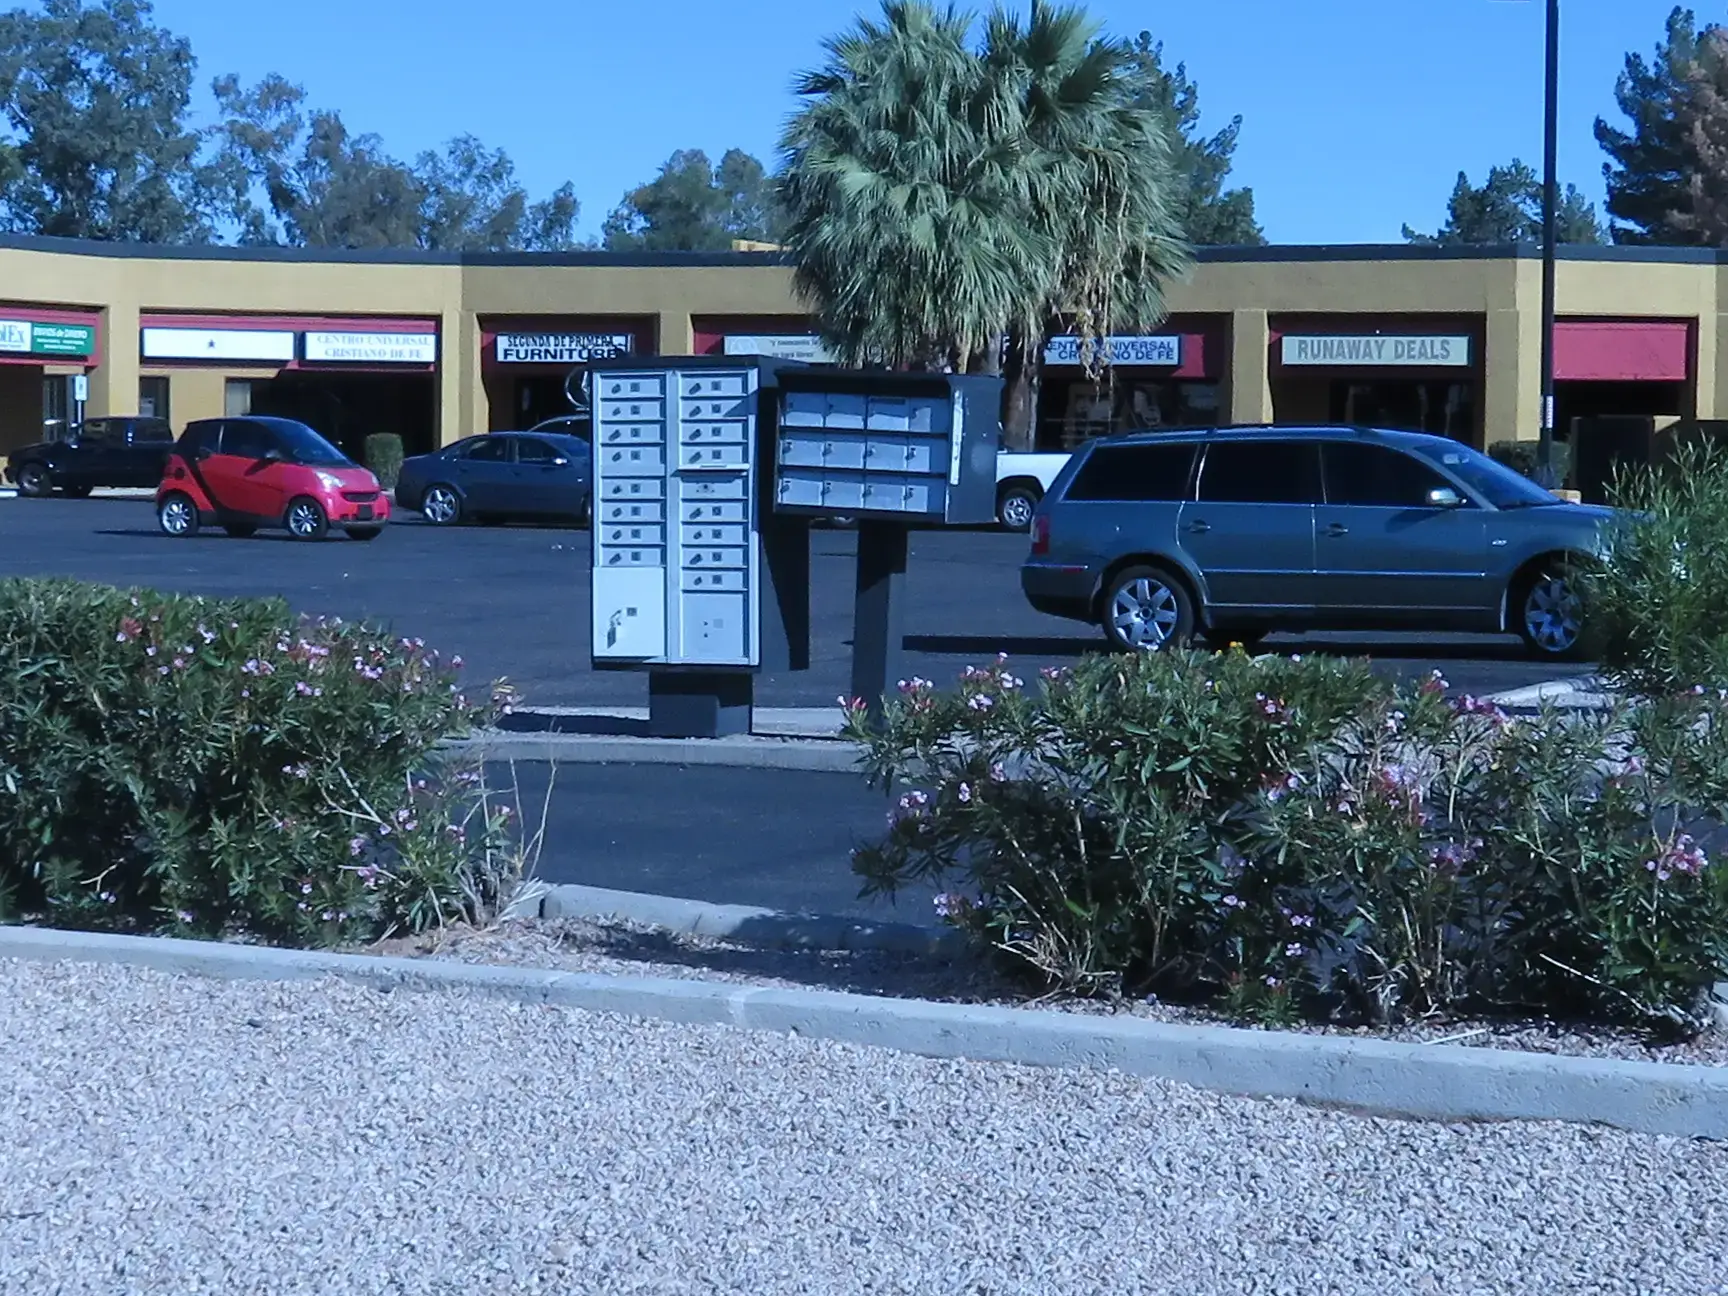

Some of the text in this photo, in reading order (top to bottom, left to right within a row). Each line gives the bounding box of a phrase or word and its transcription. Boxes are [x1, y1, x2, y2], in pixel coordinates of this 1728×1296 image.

[553, 335, 567, 348] DE
[503, 348, 619, 361] FURNITURE
[1134, 351, 1154, 361] DE
[1157, 351, 1174, 361] FE
[1297, 339, 1451, 360] RUNAWAY DEALS
